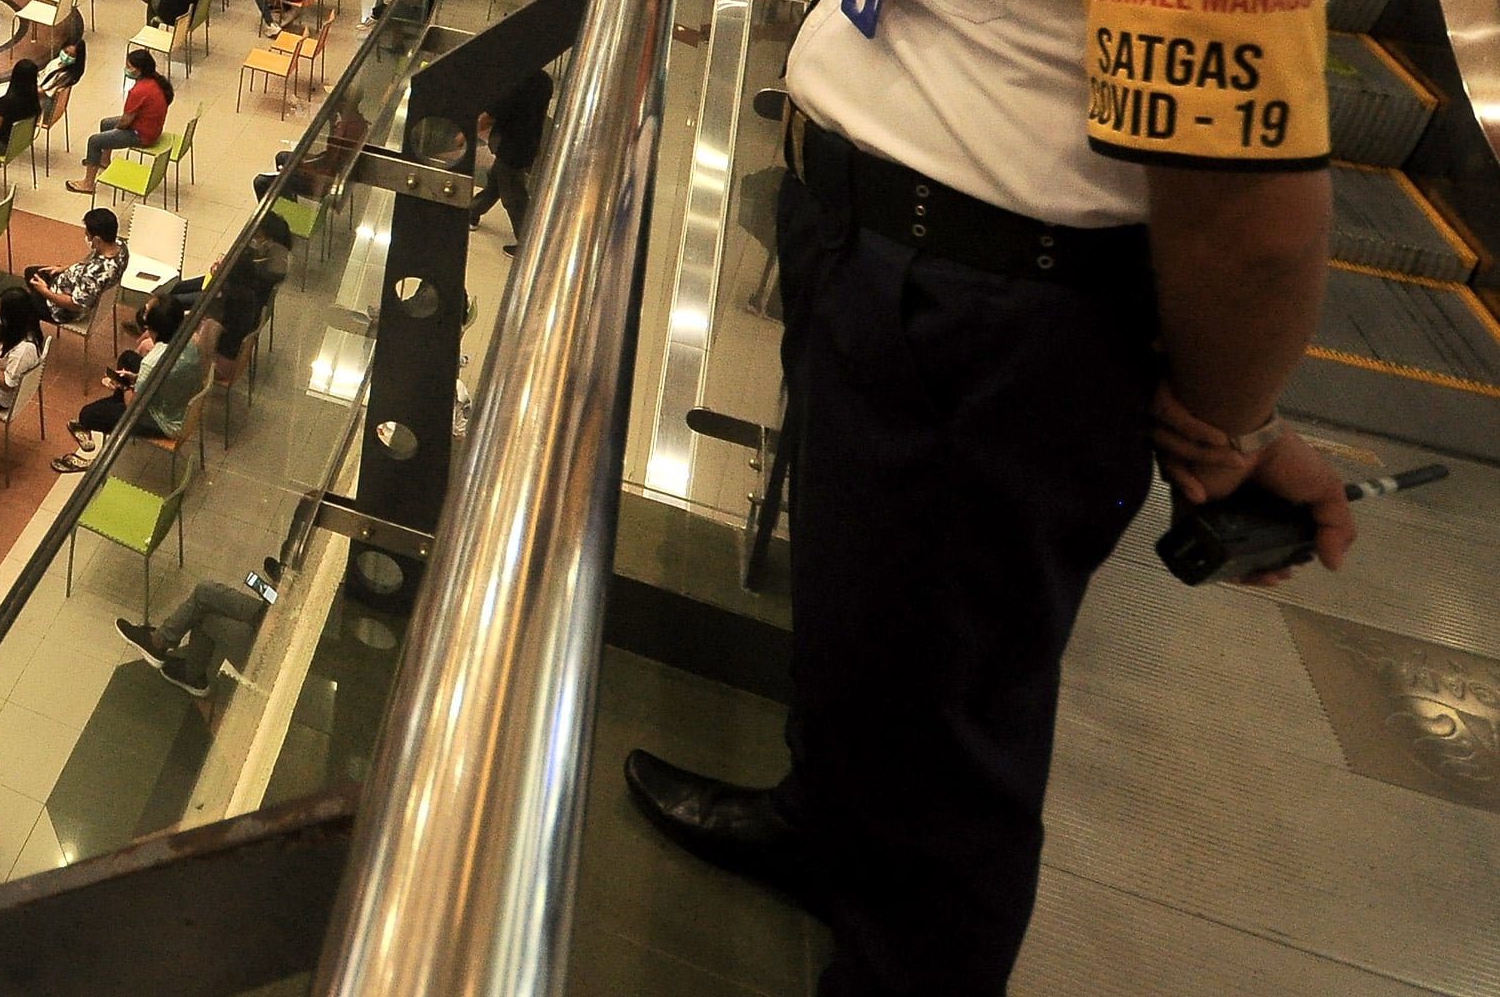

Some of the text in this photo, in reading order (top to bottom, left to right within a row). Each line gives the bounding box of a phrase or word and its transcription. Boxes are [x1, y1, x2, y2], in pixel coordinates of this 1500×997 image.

[1097, 27, 1264, 92] SATGAS
[1088, 76, 1178, 140] COVID
[1235, 99, 1290, 148] 19
